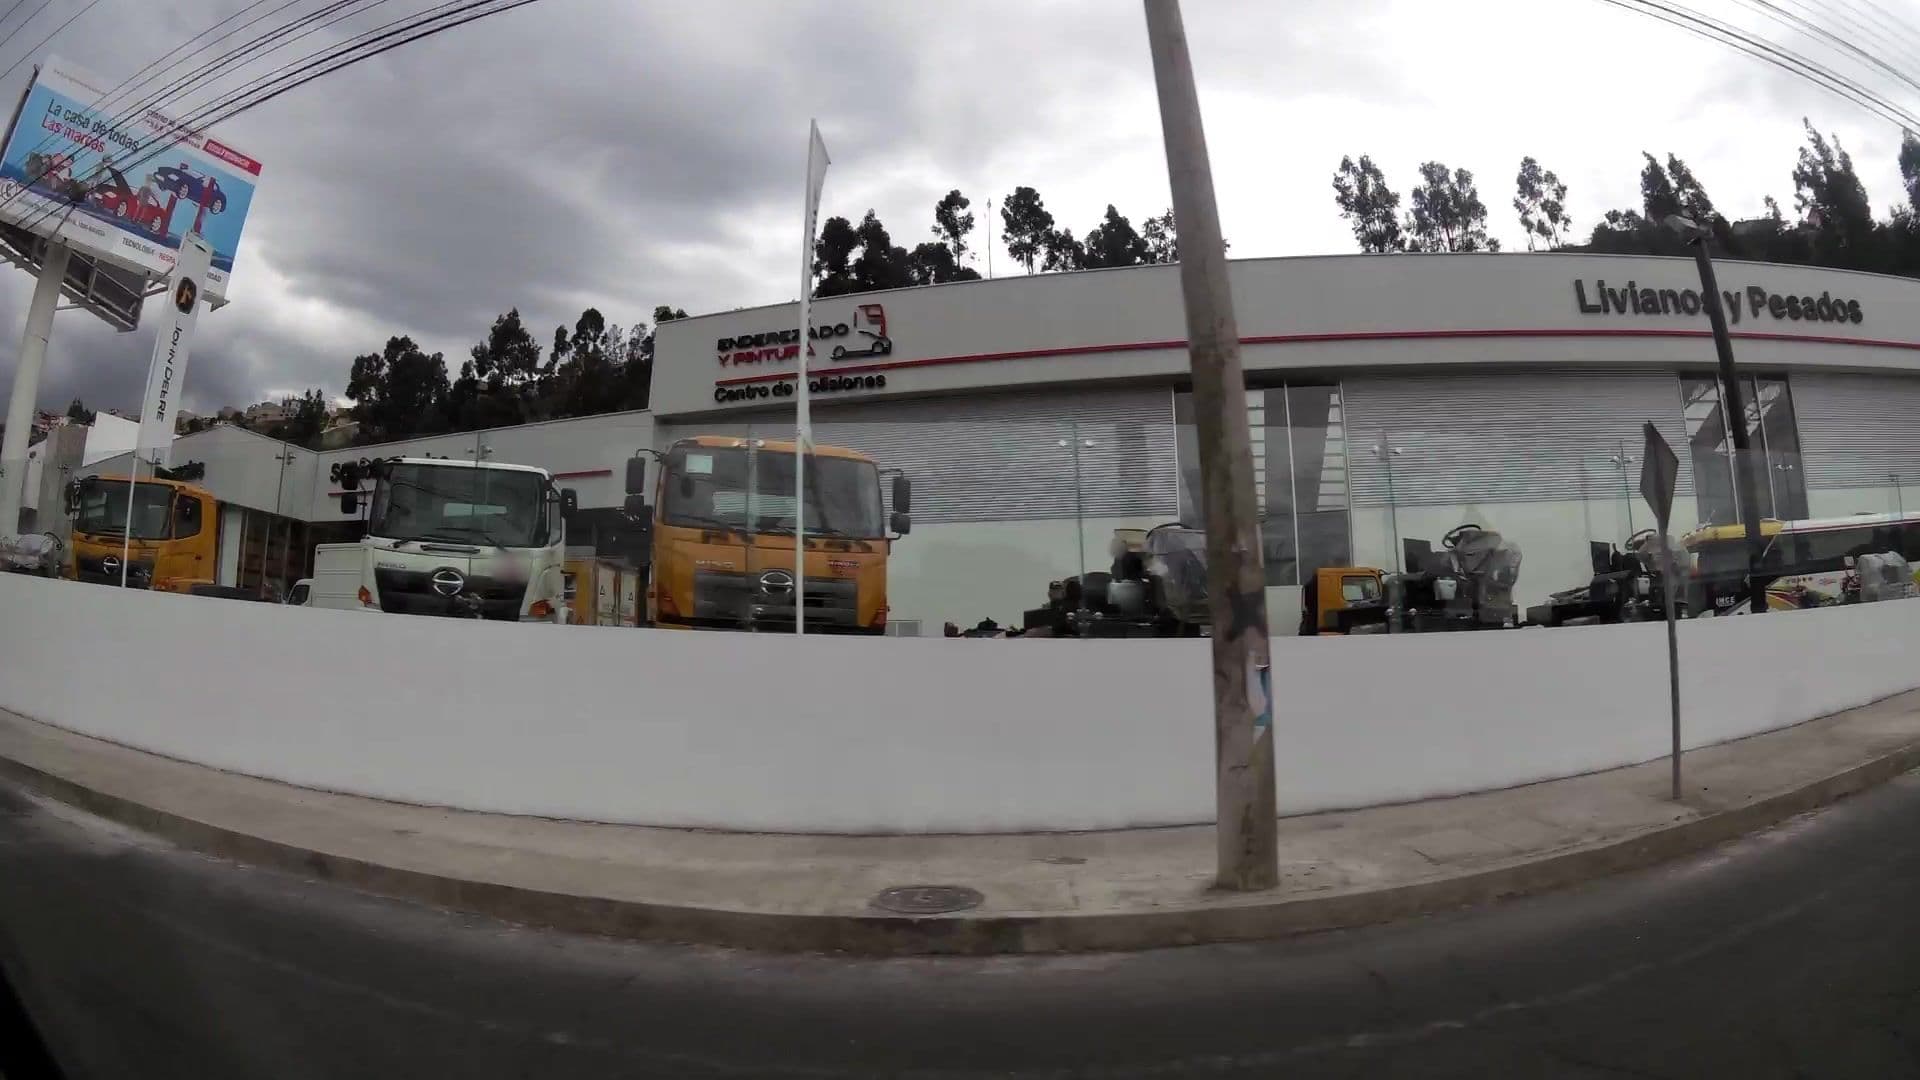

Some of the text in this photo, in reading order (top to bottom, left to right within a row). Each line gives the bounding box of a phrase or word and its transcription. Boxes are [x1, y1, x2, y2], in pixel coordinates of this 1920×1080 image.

[41, 113, 106, 153] Las marcas
[47, 97, 62, 116] La
[64, 108, 90, 129] casa
[92, 119, 107, 134] de
[107, 127, 140, 153] todas
[121, 237, 155, 257] TECNOLOA
[1722, 289, 1742, 324] y
[1747, 285, 1864, 325] Pesados
[717, 322, 849, 352] ENDEREZADO
[156, 321, 183, 423] JOHN DEERE
[718, 354, 730, 368] Y
[714, 373, 887, 403] Centro de olisiones
